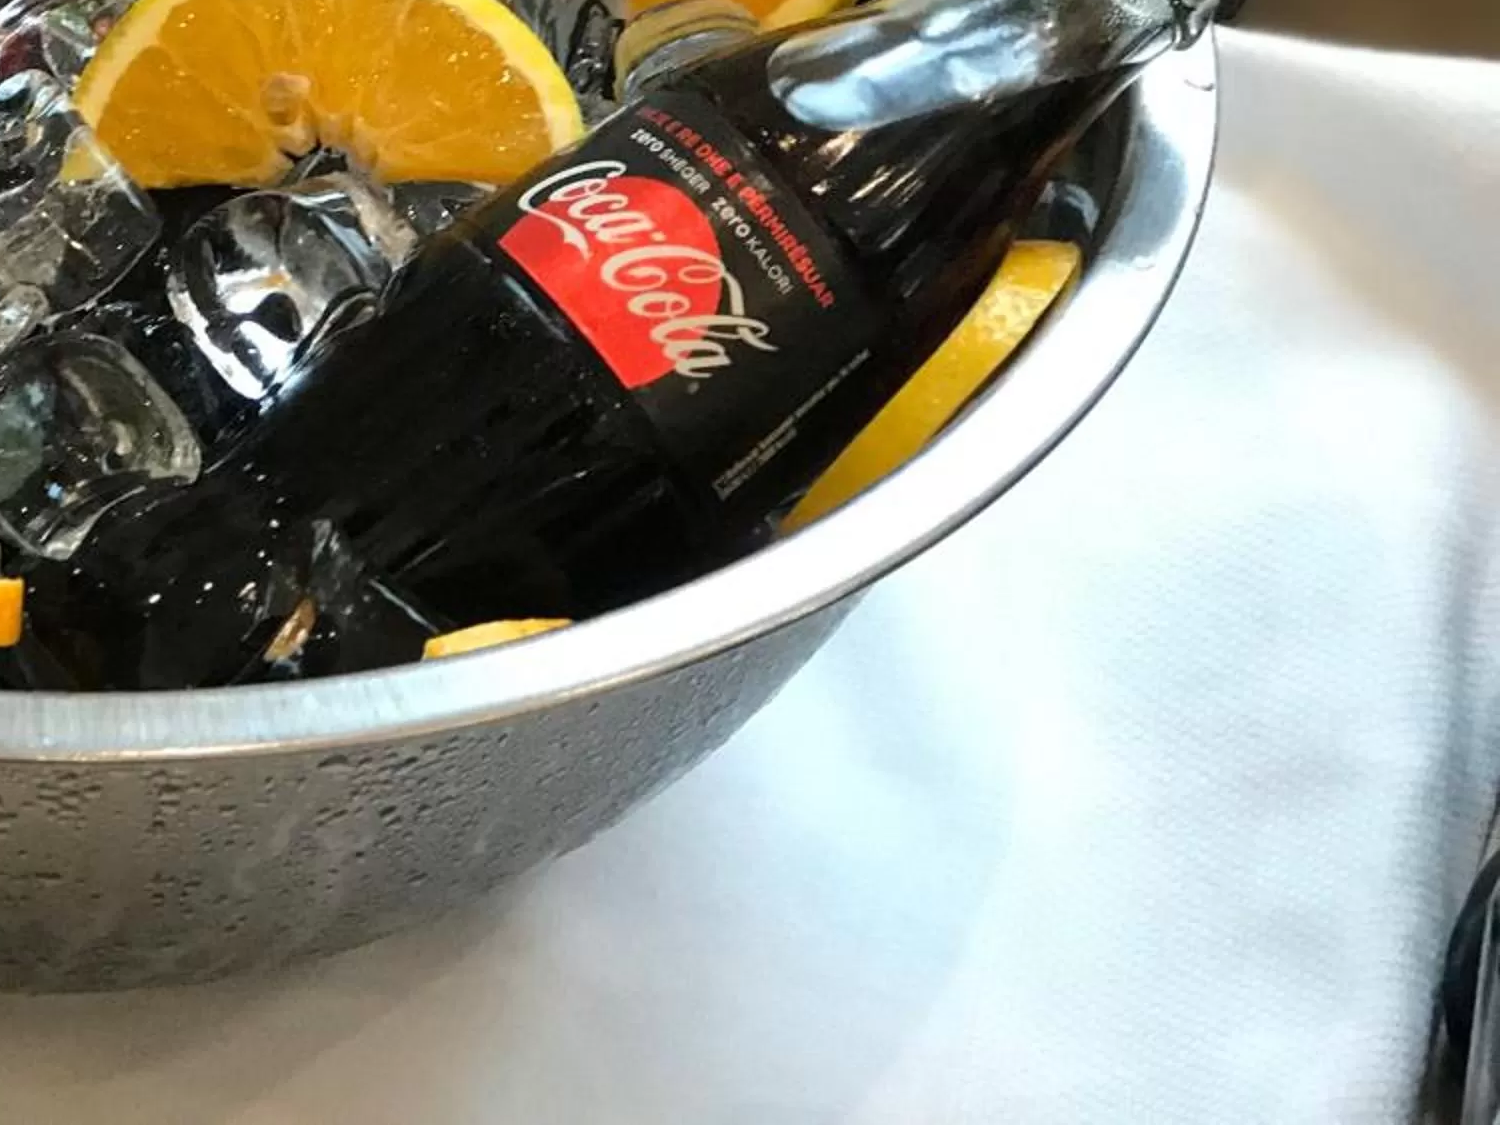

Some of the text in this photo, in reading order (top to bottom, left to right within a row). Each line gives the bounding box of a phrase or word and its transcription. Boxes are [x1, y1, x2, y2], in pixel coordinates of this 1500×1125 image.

[630, 128, 795, 295] zero SHEQER zero KALORI
